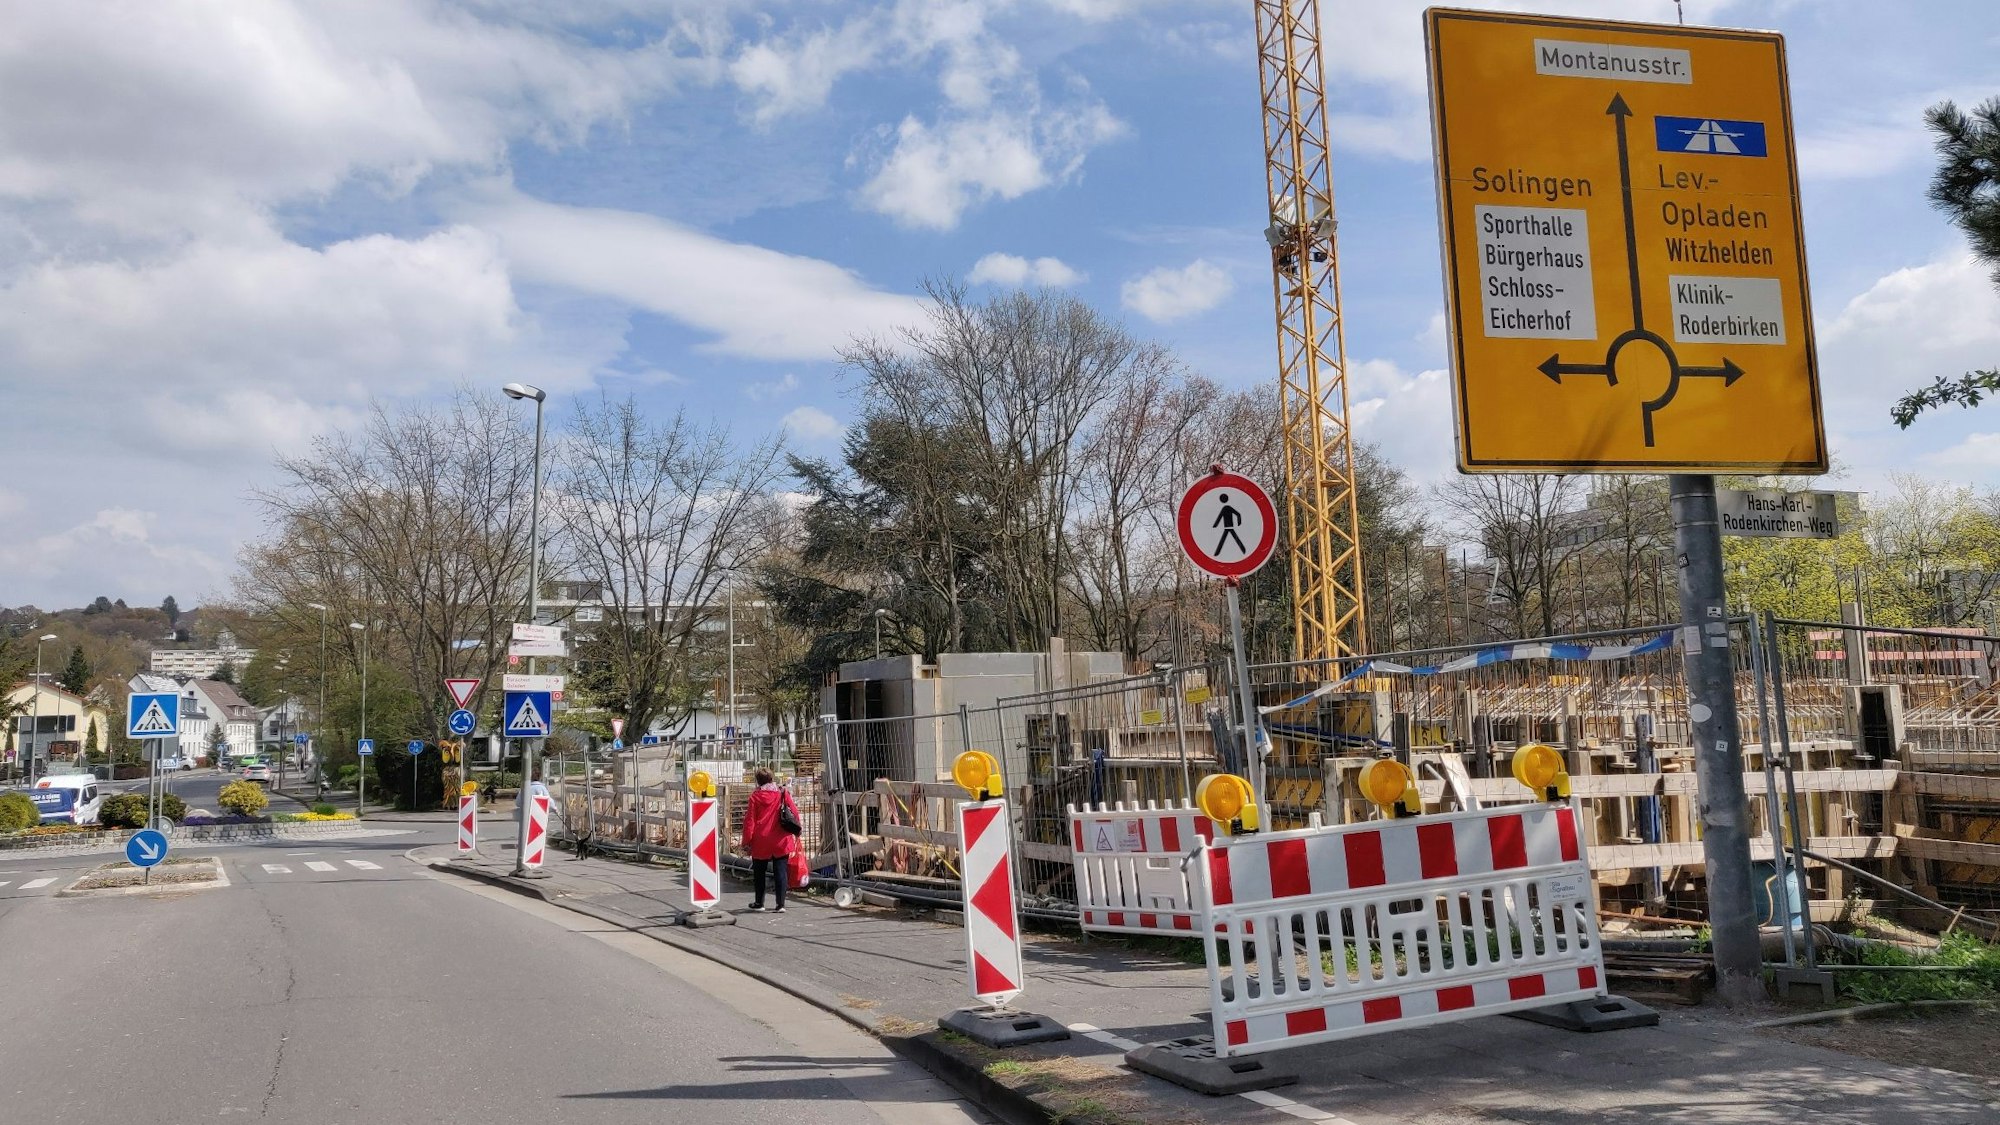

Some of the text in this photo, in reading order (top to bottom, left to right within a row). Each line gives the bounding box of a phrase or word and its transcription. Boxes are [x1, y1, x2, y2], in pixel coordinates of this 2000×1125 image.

[1541, 46, 1686, 76] Montanusstr.
[1472, 166, 1592, 202] Solingen
[1658, 163, 1719, 190] Lev.-
[1483, 212, 1573, 239] Sporthalle
[1662, 201, 1768, 232] Opladen
[1485, 243, 1584, 272] Bürgerhaus
[1665, 237, 1774, 265] Witzhelden
[1488, 275, 1564, 299] Schloss-
[1676, 283, 1734, 305] Klinik-
[1490, 307, 1572, 331] Eicherhof
[1680, 313, 1779, 337] Roderbirken
[1746, 494, 1813, 513] Hans-Karl-
[1723, 513, 1833, 538] Rodenkirchen-Weg
